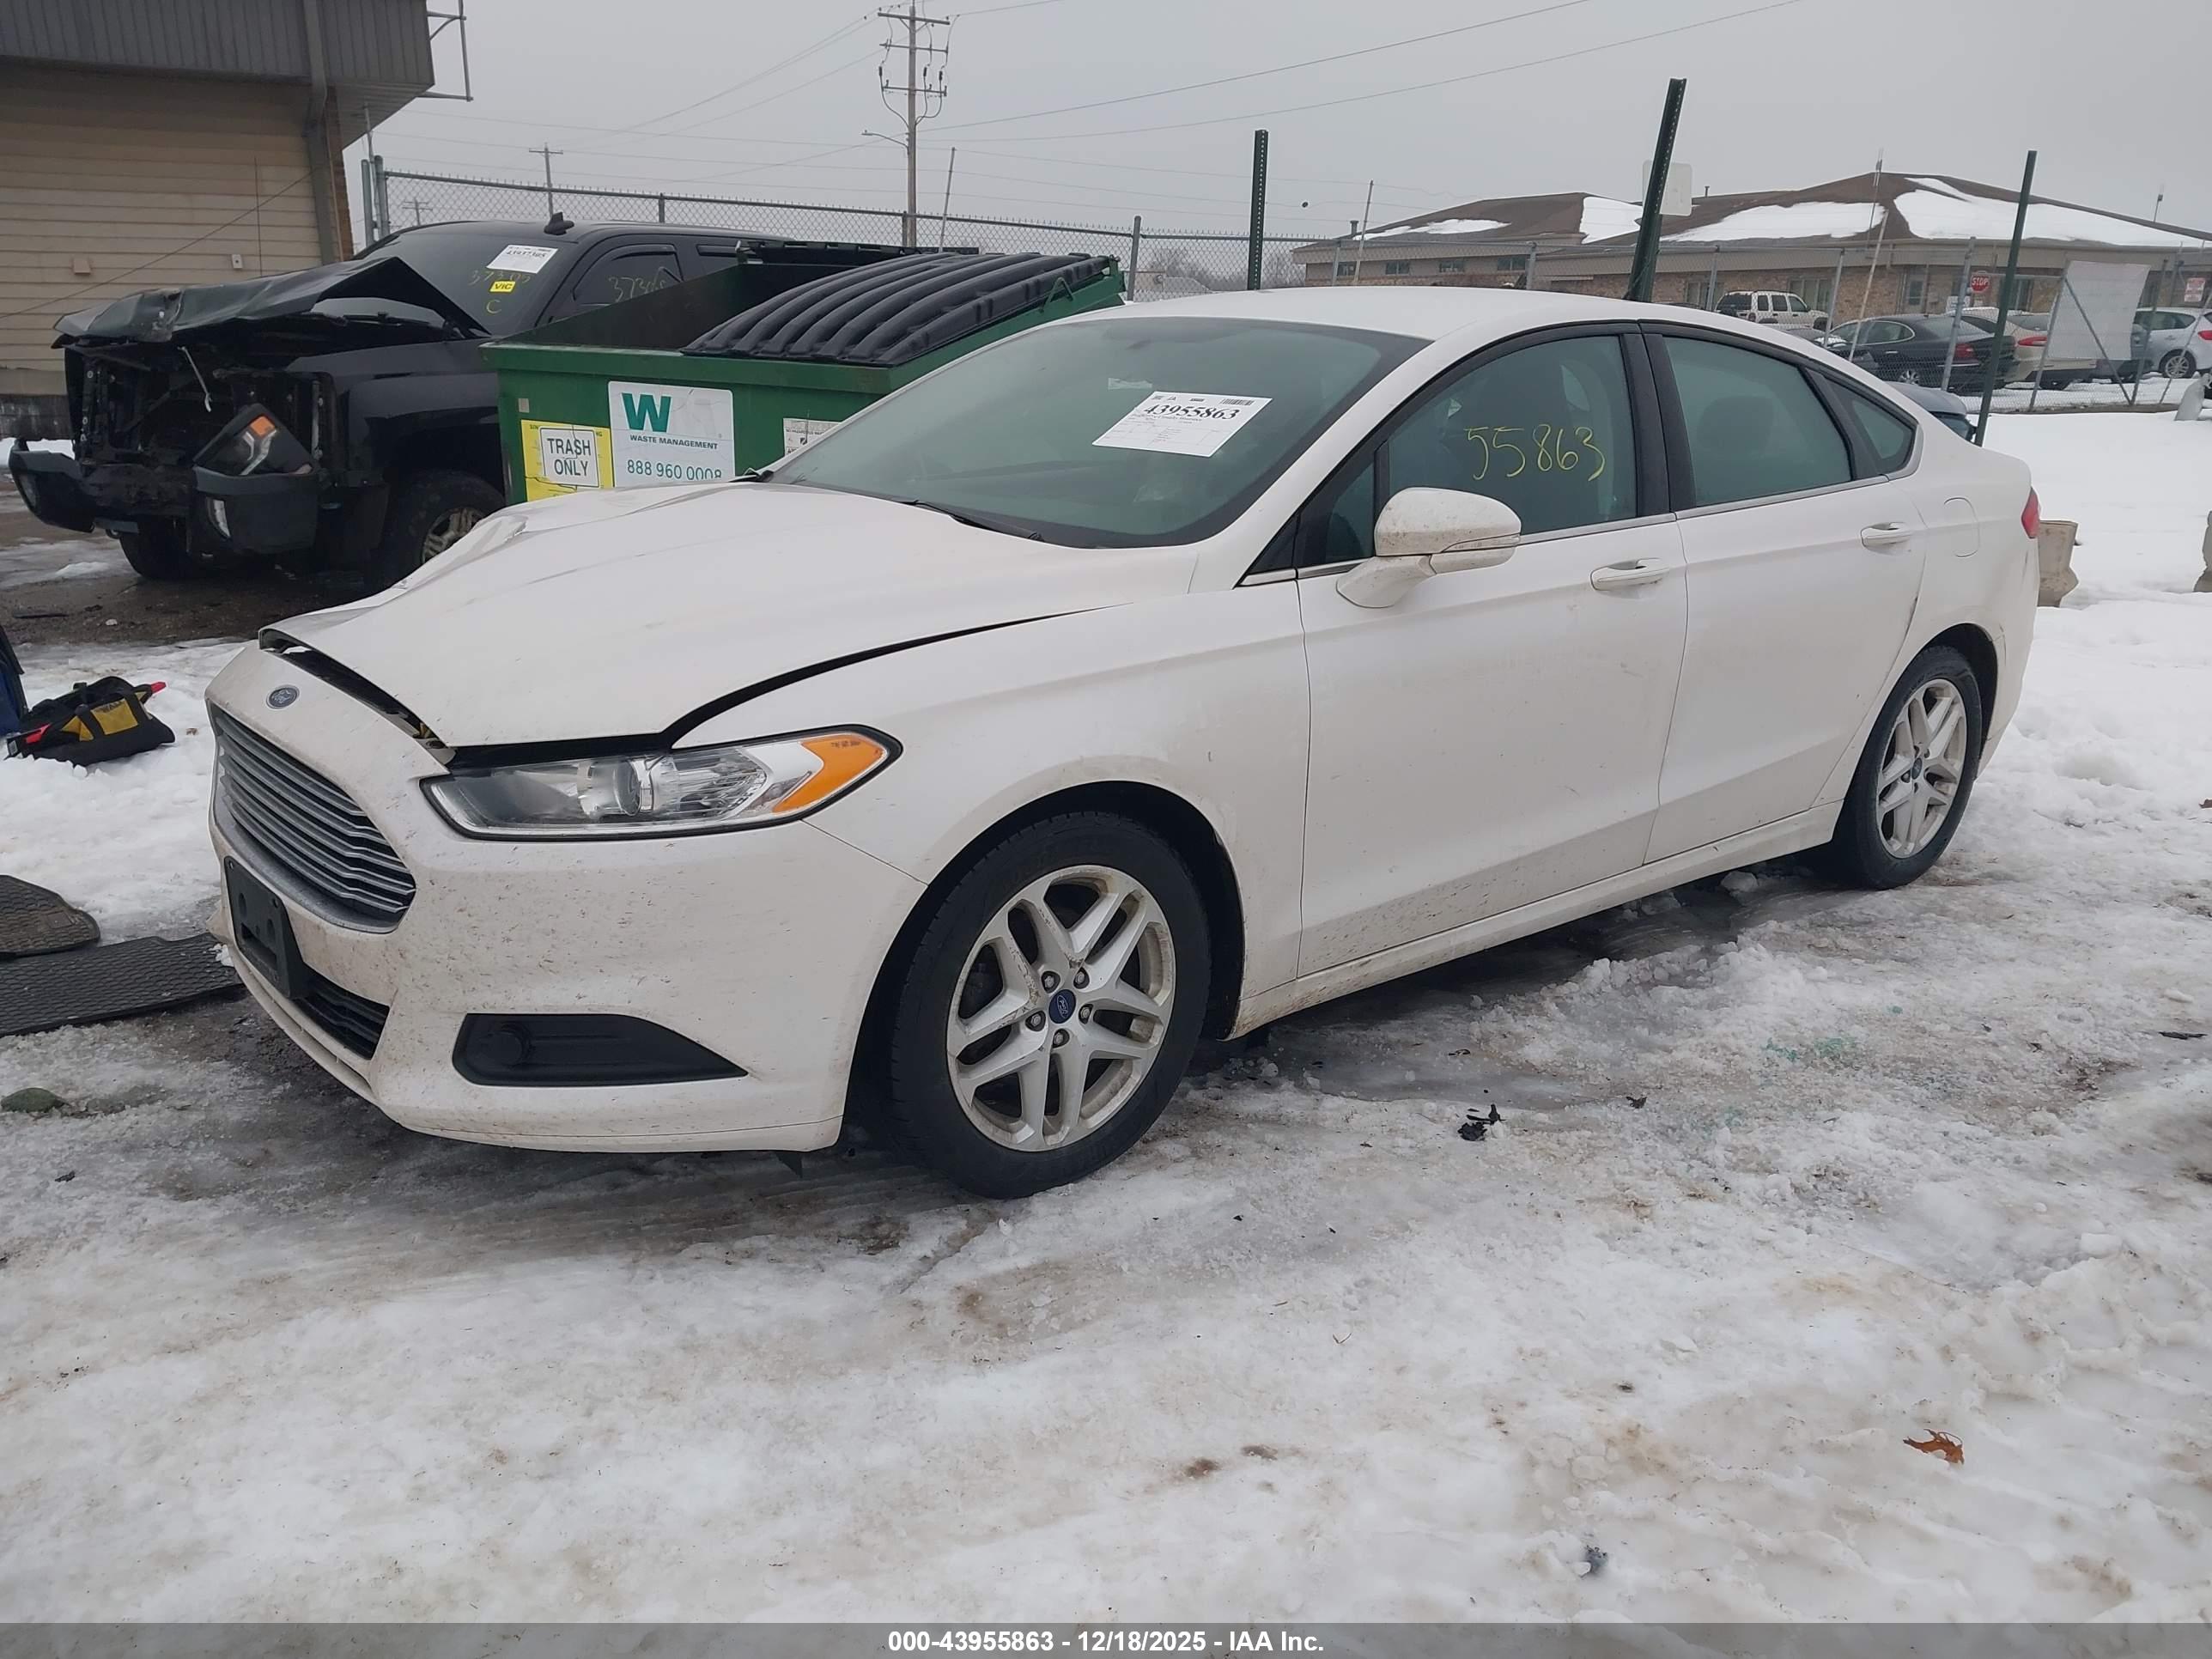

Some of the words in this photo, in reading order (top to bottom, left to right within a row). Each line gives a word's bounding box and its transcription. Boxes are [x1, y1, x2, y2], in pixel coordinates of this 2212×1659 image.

[1972, 277, 1989, 286] STOP
[486, 299, 502, 314] C
[621, 392, 672, 433] W
[1143, 404, 1241, 421] 43955863
[546, 438, 592, 456] TRASH
[629, 434, 658, 444] WASTE
[659, 437, 719, 450] MANAGEMENT
[1462, 423, 1606, 482] 55863
[554, 459, 589, 477] ONLY
[627, 459, 653, 476] 888
[656, 462, 683, 479] 960
